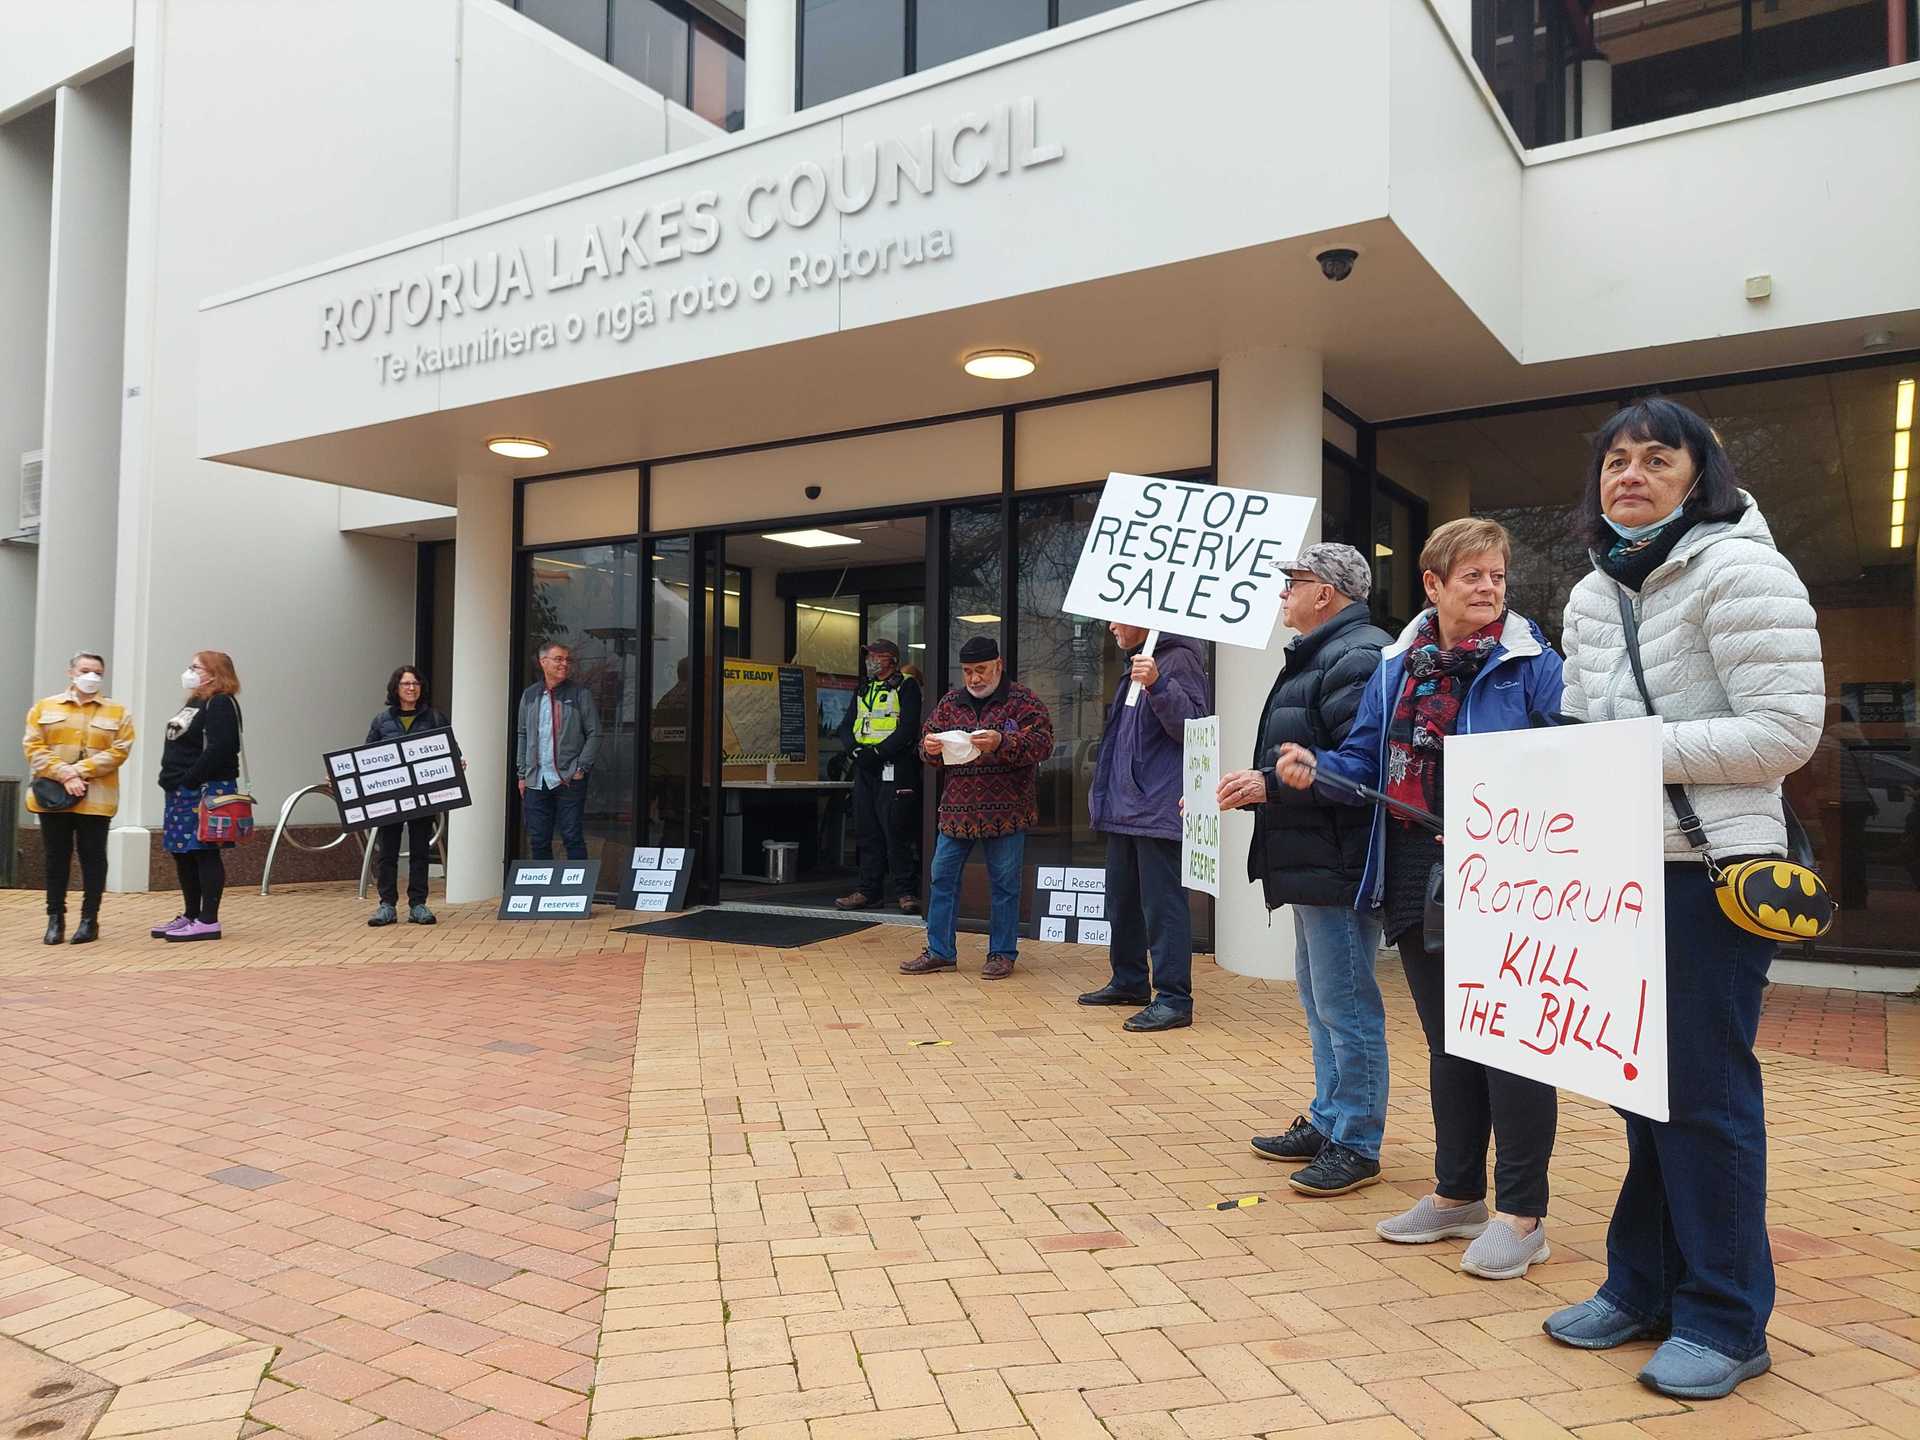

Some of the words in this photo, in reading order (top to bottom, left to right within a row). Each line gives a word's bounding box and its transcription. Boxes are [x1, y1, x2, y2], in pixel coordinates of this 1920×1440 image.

[320, 244, 534, 348] ROTORUA
[547, 190, 721, 294] LAKES
[737, 95, 1064, 240] COUNCIL
[374, 351, 407, 383] Te
[414, 318, 557, 374] kaunihera
[564, 312, 585, 342] o
[594, 288, 656, 342] ngā
[664, 270, 739, 319] roto
[750, 269, 773, 301] o
[784, 225, 952, 294] Rotorua
[1134, 482, 1269, 532] STOP
[1090, 515, 1283, 579] RESERVE
[1098, 562, 1258, 624] SALES
[725, 669, 740, 679] GET
[743, 671, 774, 681] READY
[337, 762, 351, 772] He
[361, 751, 396, 766] taonga
[367, 775, 406, 790] whenua
[1186, 812, 1202, 845] SAVE
[1204, 814, 1218, 848] OUR
[1465, 782, 1579, 854] Save
[520, 871, 548, 882] Hands
[566, 873, 580, 882] off
[638, 855, 656, 866] Keep
[1189, 850, 1216, 884] RESERVE
[639, 877, 673, 887] Reserves
[1043, 876, 1063, 887] Our
[1458, 853, 1644, 928] ROTORUA
[543, 901, 580, 909] reserves
[1055, 903, 1073, 912] are
[1083, 904, 1100, 914] not
[1047, 926, 1063, 937] for
[1084, 930, 1108, 941] sale!
[1499, 932, 1589, 991] KILL
[1458, 983, 1508, 1039] THE
[1519, 979, 1648, 1081] BILL!
